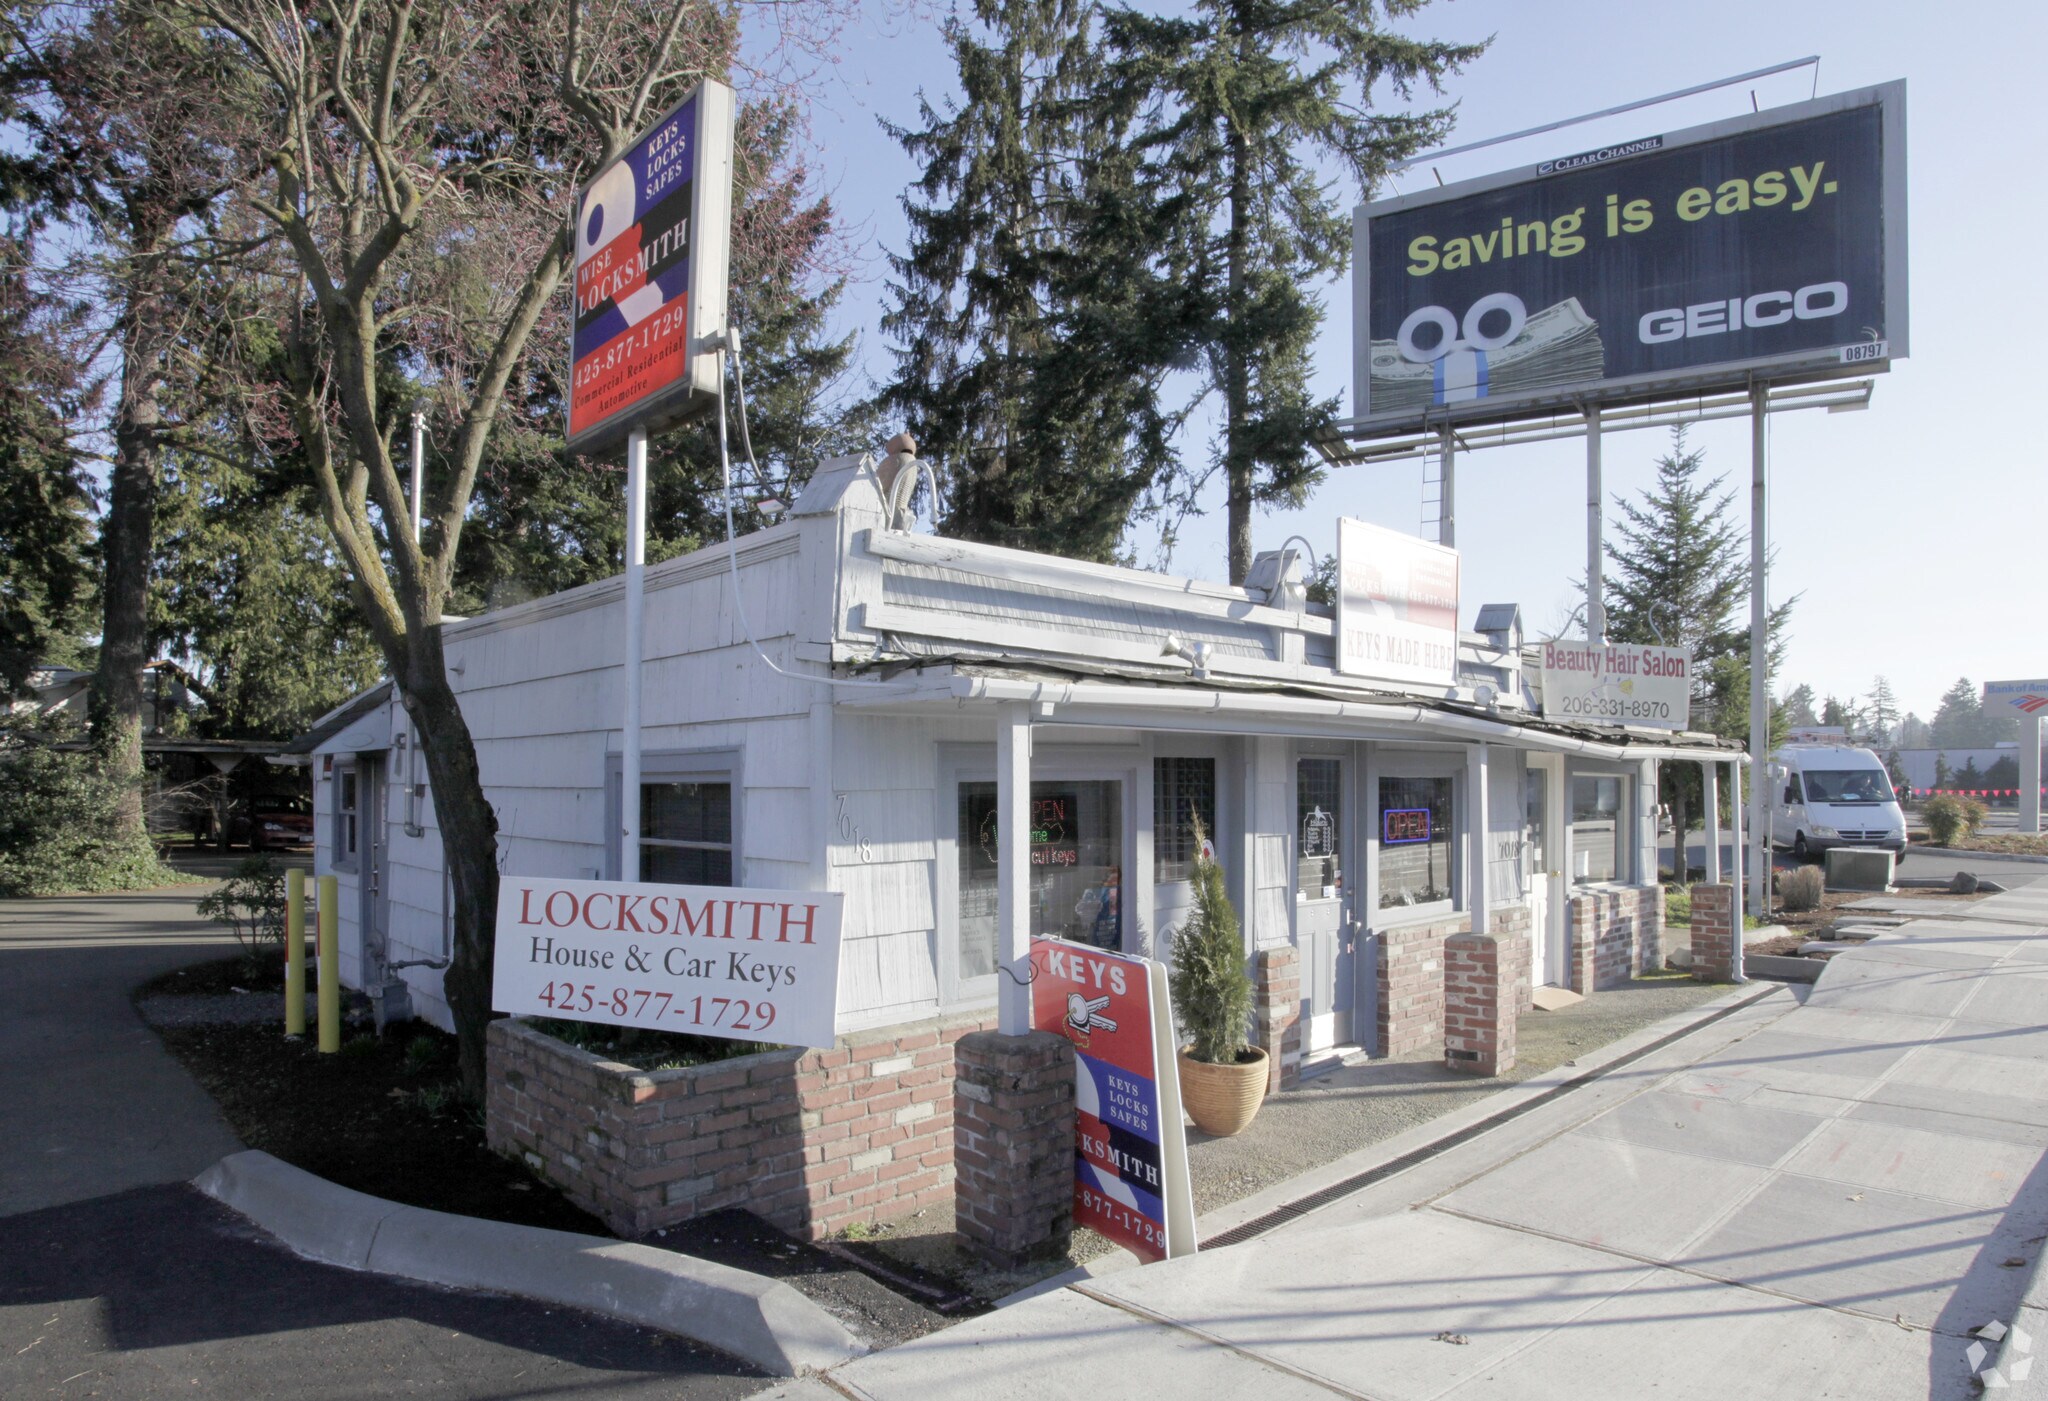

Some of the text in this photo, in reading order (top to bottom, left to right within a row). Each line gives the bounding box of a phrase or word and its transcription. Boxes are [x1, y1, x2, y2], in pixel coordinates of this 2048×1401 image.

[646, 136, 687, 179] LOCKS
[647, 121, 679, 158] KEYS
[645, 160, 683, 200] SAFES
[1406, 161, 1838, 277] Saving is easy.
[577, 217, 688, 318] LOCKSMITH
[580, 248, 613, 286] WISE
[1638, 281, 1848, 345] GEICO
[575, 306, 684, 388] 425-877-1729
[1844, 342, 1883, 362] 08797
[573, 336, 683, 410] Commercial Residential
[597, 378, 648, 414] Automotive
[1346, 628, 1452, 671] KEYS MADE HERE
[1545, 642, 1685, 679] Beauty Hair Salon
[1562, 695, 1669, 719] 206-331-8970
[1987, 684, 2014, 694] Bank
[836, 793, 872, 863] 7018
[1031, 799, 1065, 822] PEN
[1387, 812, 1427, 840] OPEN
[1051, 846, 1076, 867] keys
[517, 888, 820, 945] LOCKSMITH
[529, 936, 796, 992] House & Car Keys
[1048, 948, 1127, 996] KEYS
[538, 980, 777, 1032] 425-877-1729
[1108, 1074, 1139, 1097] KEYS
[1109, 1090, 1149, 1117] LOCKS
[1110, 1106, 1148, 1131] SAFES
